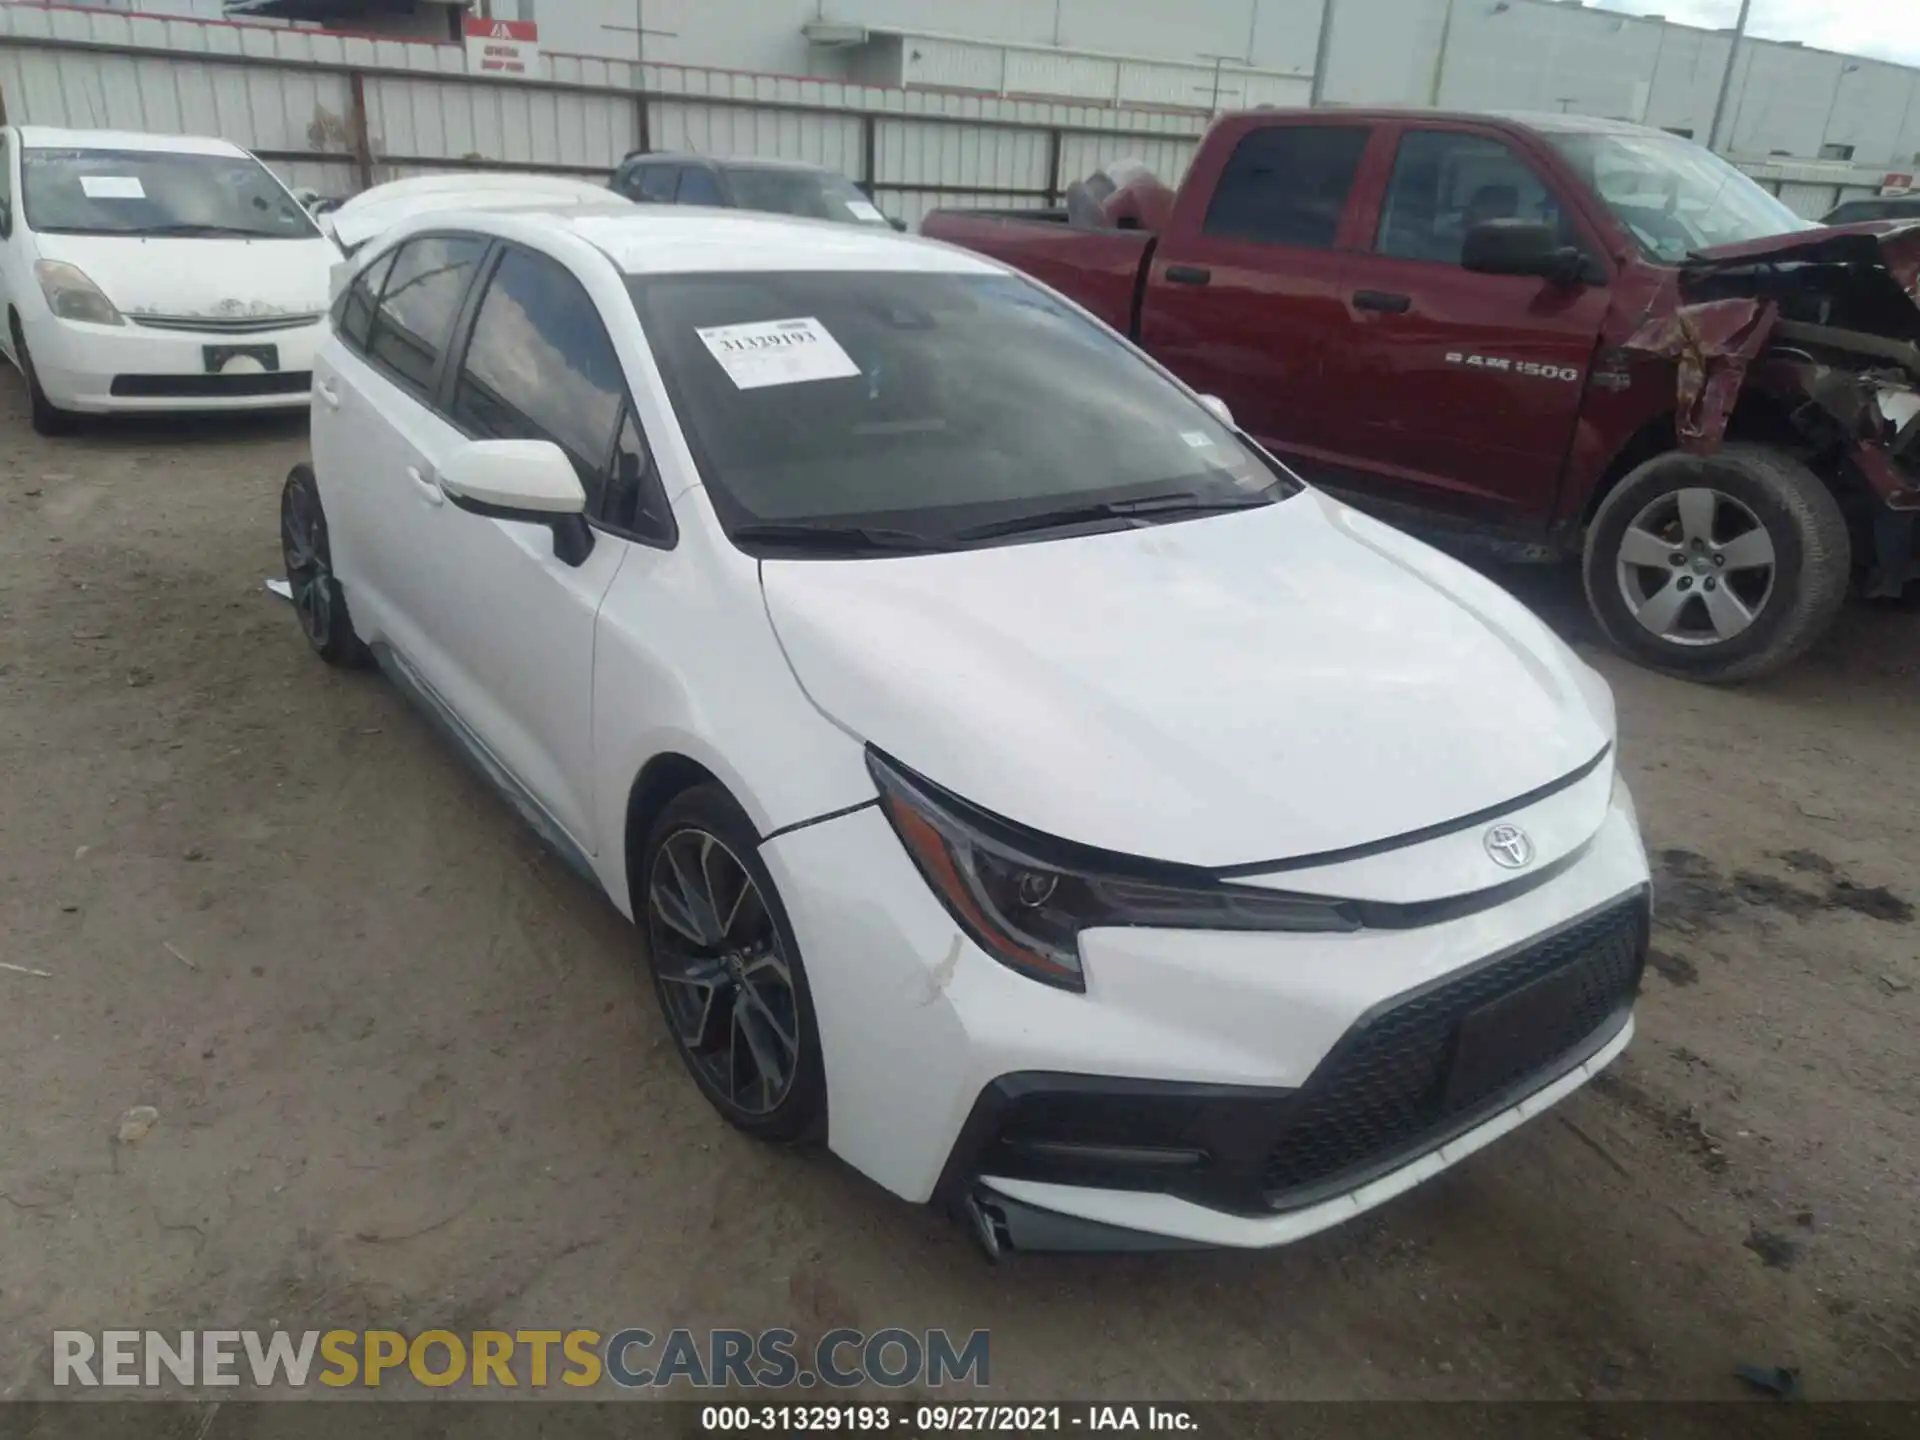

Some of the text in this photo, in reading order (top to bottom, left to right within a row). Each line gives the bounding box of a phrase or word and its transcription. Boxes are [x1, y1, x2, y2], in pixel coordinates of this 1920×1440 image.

[719, 331, 817, 352] 31329193
[1445, 353, 1511, 371] RAM
[1516, 361, 1578, 381] 1500
